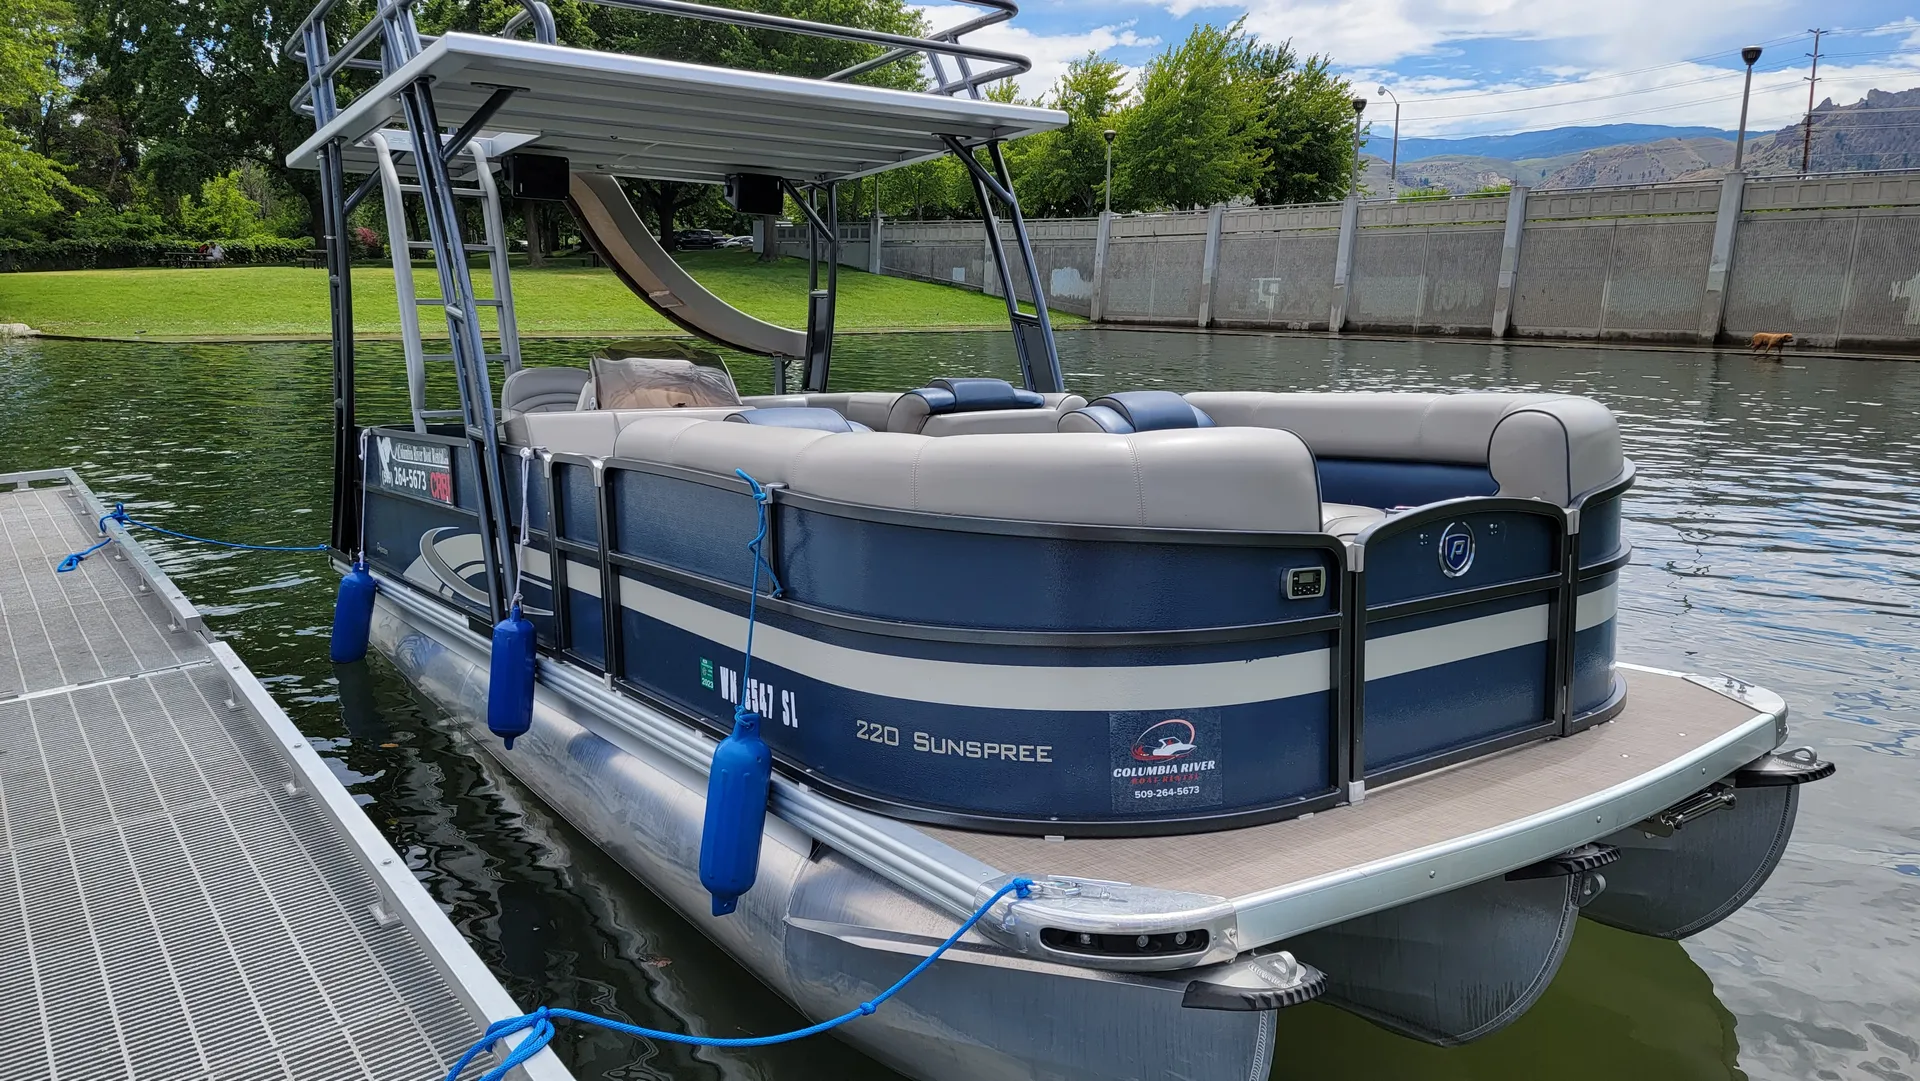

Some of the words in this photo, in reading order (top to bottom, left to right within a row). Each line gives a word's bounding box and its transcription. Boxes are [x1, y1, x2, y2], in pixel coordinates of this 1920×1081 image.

[394, 467, 426, 490] 264-5673
[702, 678, 713, 689] 2023
[720, 666, 737, 704] WN
[781, 689, 798, 728] SL
[856, 719, 899, 747] 220
[1114, 765, 1178, 778] COLUMBIA
[1181, 761, 1215, 773] RIVER
[1134, 786, 1200, 798] 509-264-5673
